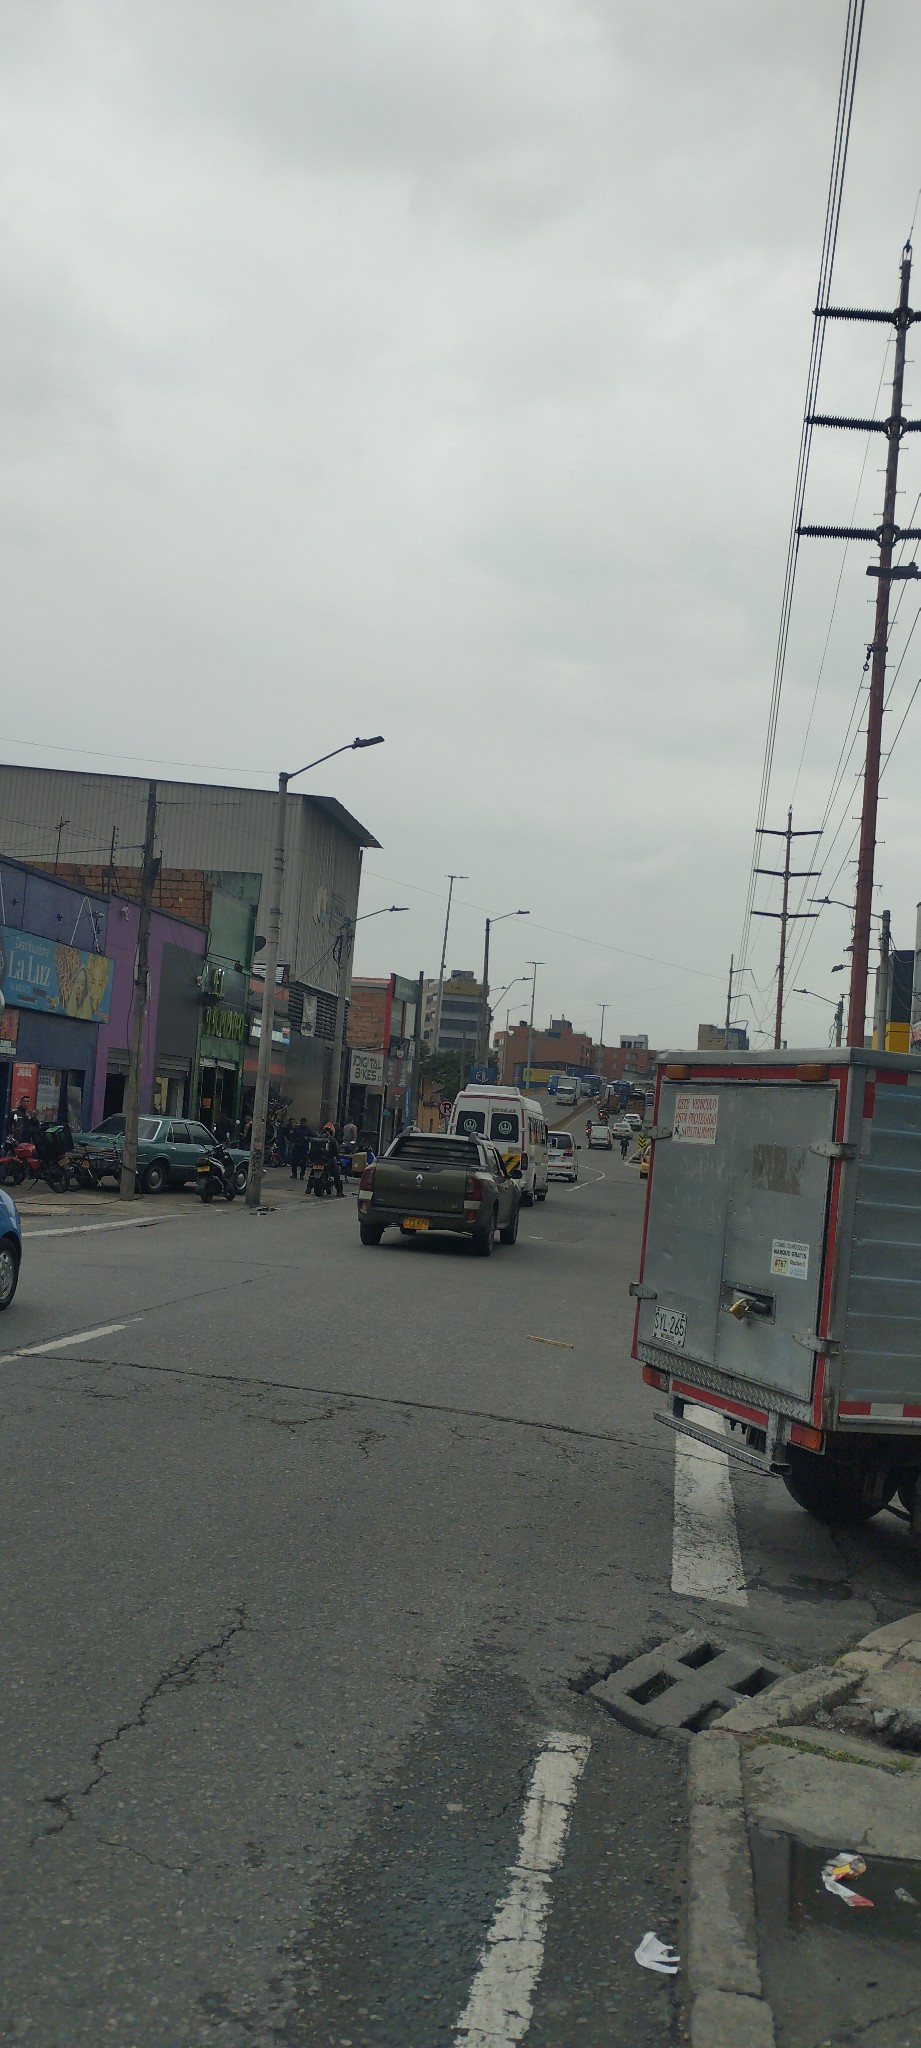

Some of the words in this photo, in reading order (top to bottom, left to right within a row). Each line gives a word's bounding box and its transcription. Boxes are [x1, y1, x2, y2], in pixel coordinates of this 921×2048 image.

[8, 950, 24, 980] La
[27, 955, 50, 986] Luz
[353, 1055, 381, 1070] DIGITAL
[354, 1067, 377, 1081] BIKES
[677, 1098, 690, 1110] ESTE
[688, 1112, 717, 1126] PROTEGIDO
[774, 1248, 791, 1256] MARQUE
[791, 1251, 807, 1260] GRATIS
